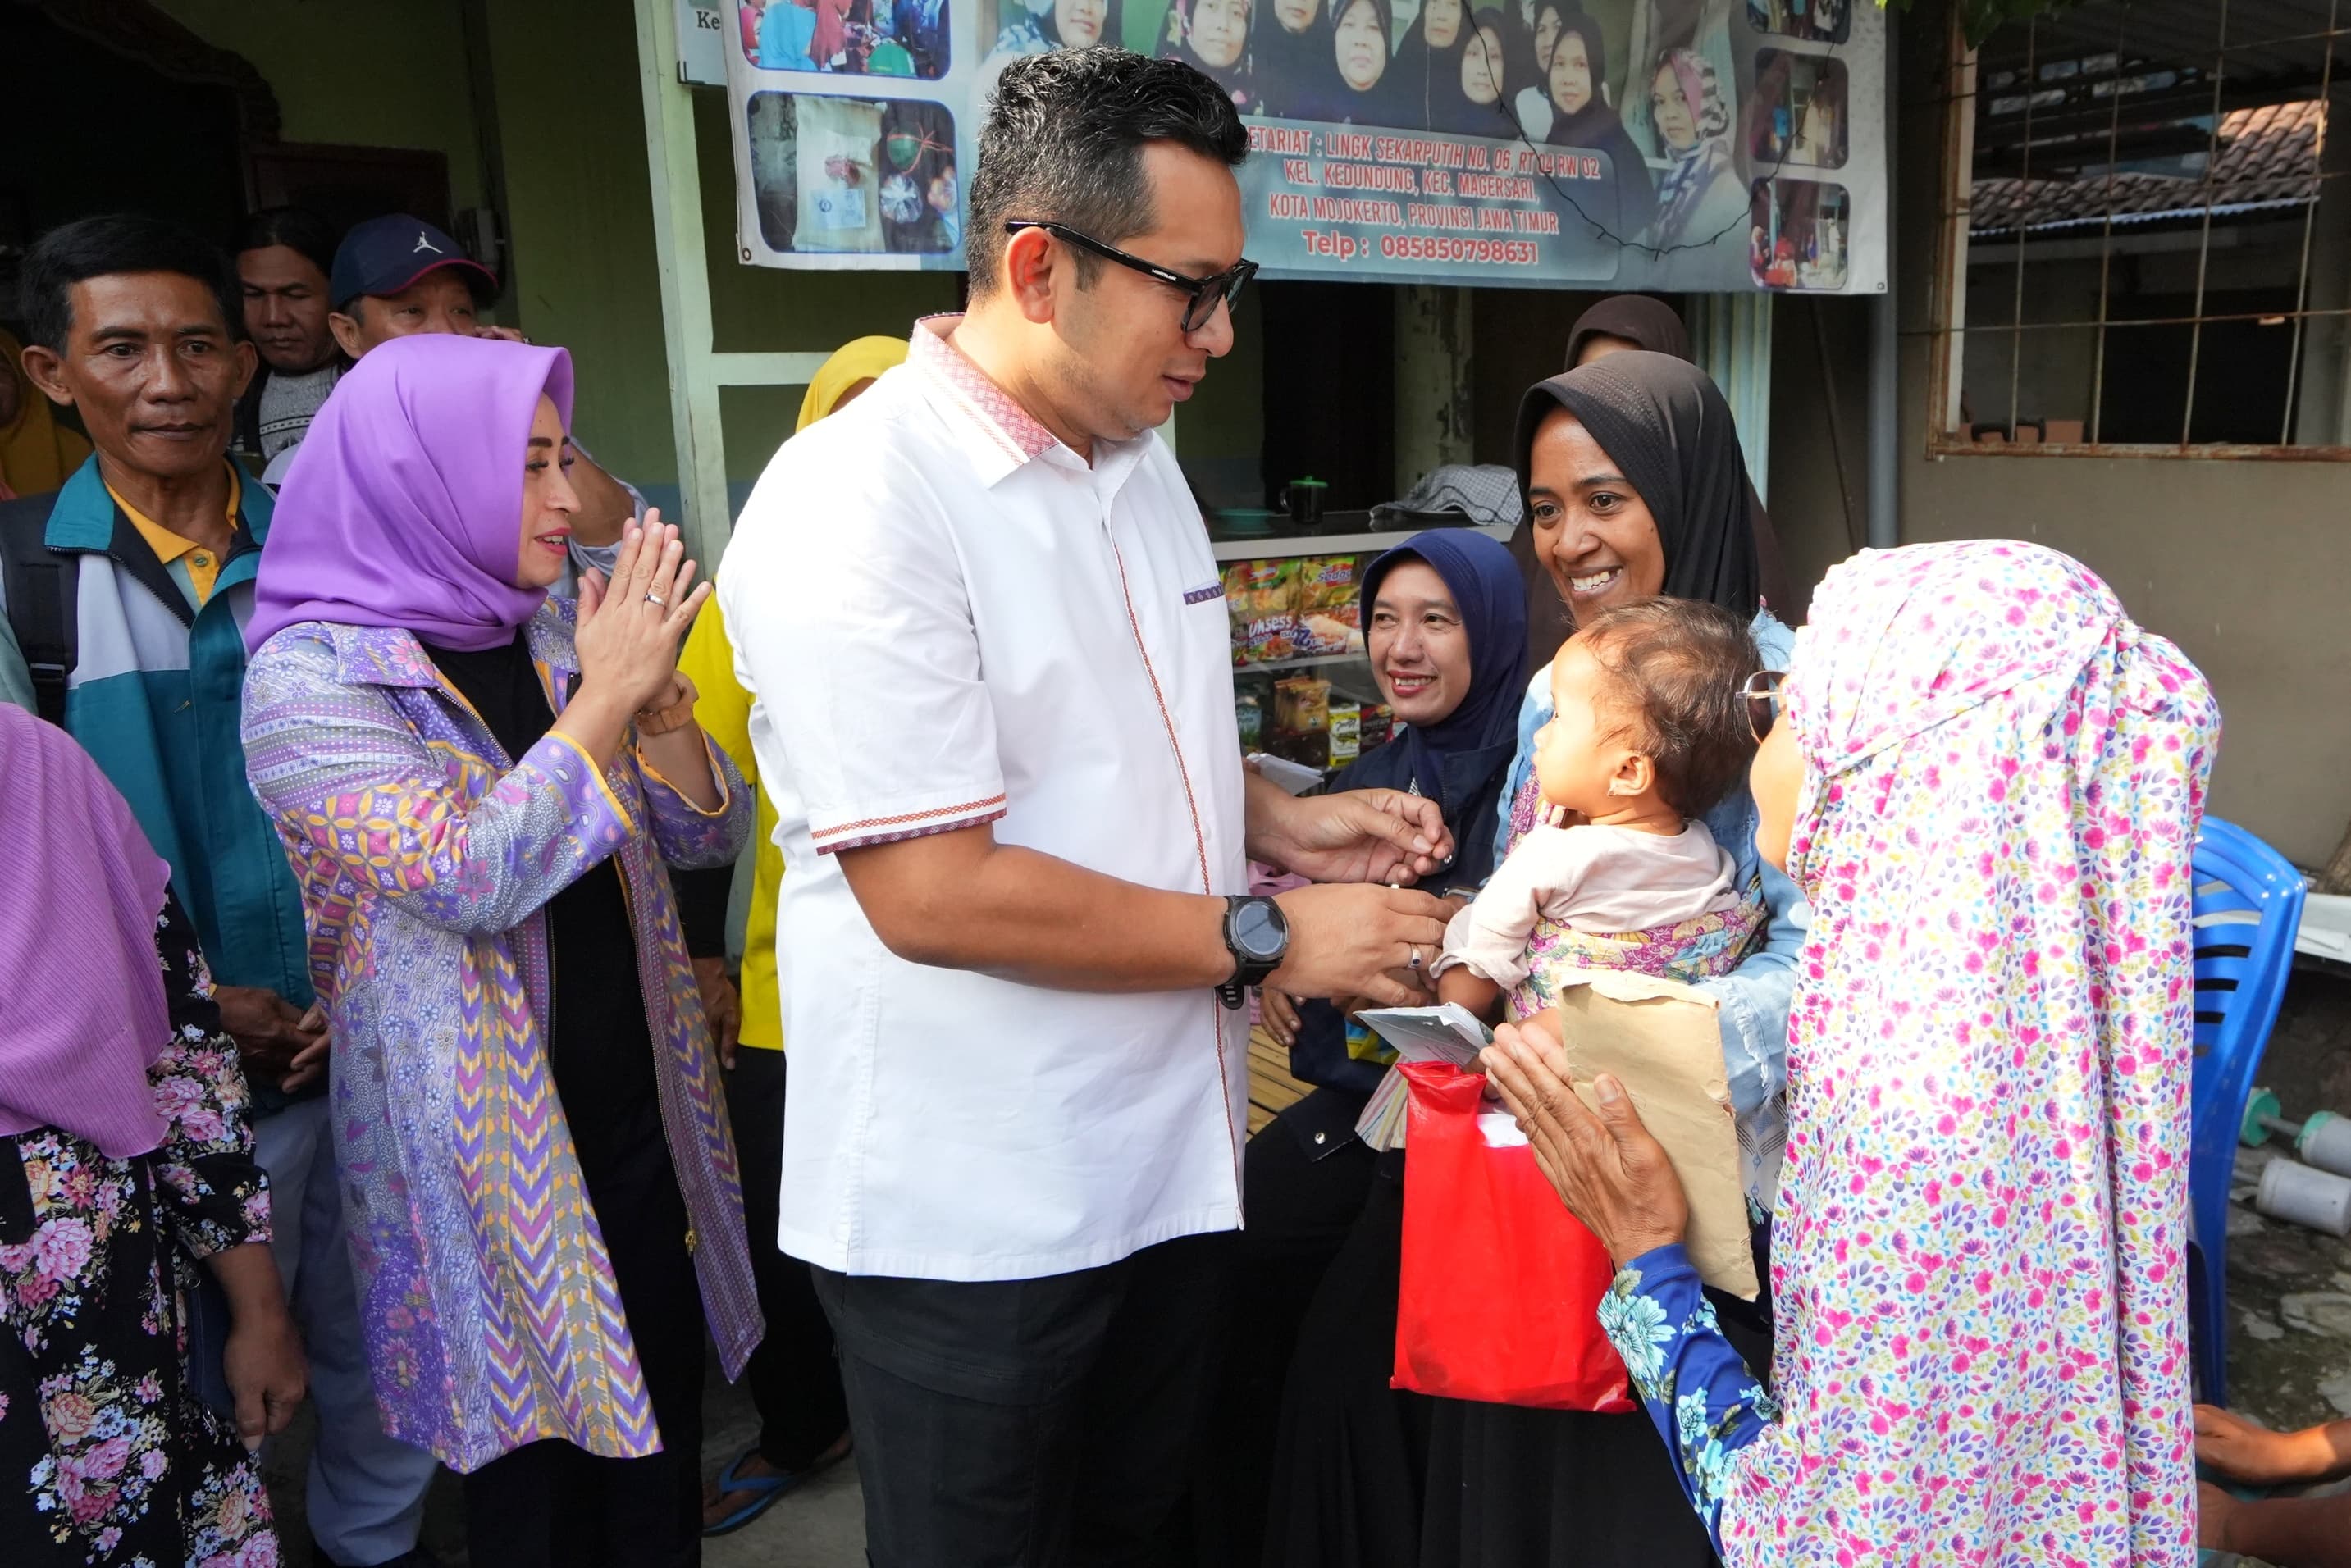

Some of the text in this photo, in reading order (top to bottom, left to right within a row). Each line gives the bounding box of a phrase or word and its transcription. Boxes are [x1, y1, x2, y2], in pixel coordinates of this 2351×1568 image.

[696, 11, 720, 30] Ke
[1247, 125, 1312, 156] ETARIAT
[1316, 136, 1322, 157] :
[1326, 131, 1372, 160] LINGK
[1375, 135, 1464, 168] SEKARPUTIH
[1467, 145, 1490, 171] NO.
[1493, 148, 1515, 175] 06,
[1518, 151, 1536, 173] RT
[1557, 154, 1578, 177] RW
[1581, 157, 1601, 179] 02
[1284, 158, 1540, 204] KEL. KEDUNDUNG, KEC. MAGERSARI,
[1269, 193, 1560, 235] KOTA MOJOKERTO, PROVINSI JAWA TIMUR
[1301, 229, 1539, 266] Telp : 085850798631
